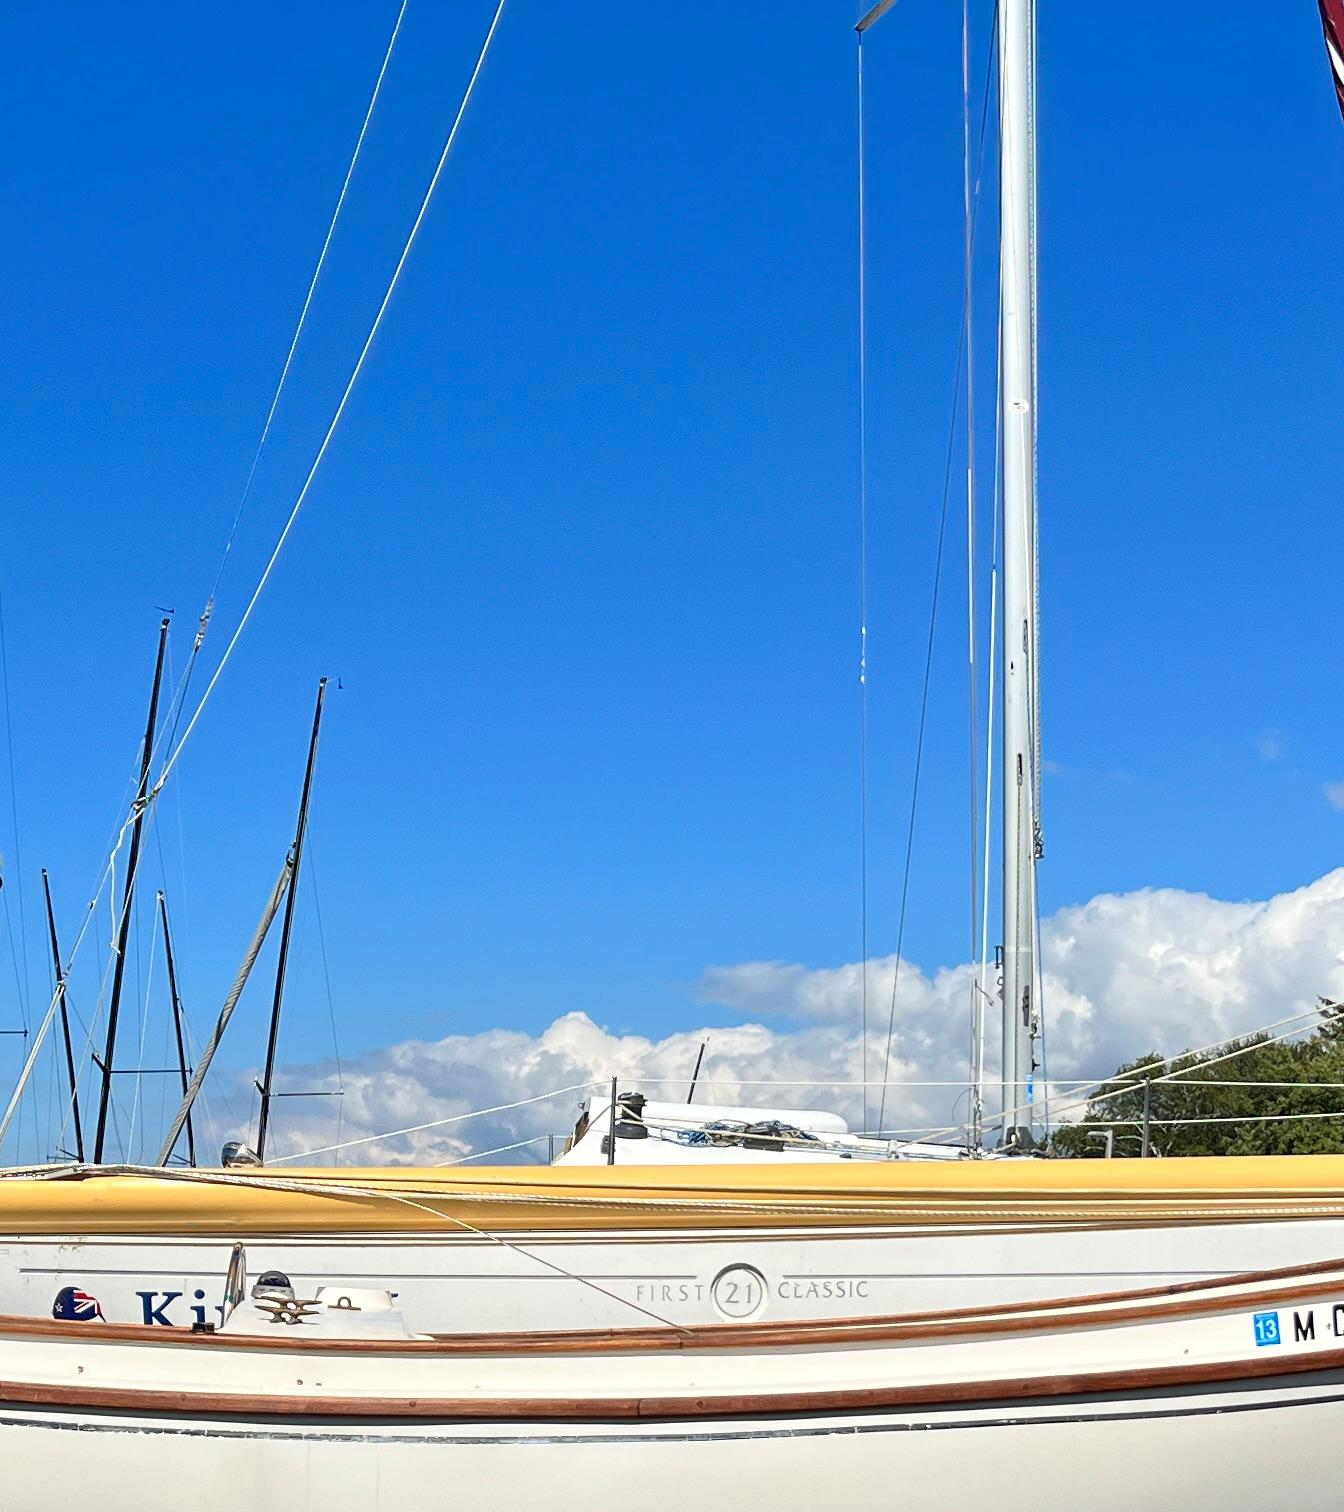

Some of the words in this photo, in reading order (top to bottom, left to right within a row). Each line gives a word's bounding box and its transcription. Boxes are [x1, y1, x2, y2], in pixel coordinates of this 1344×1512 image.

[636, 1284, 705, 1302] FIRST
[724, 1282, 753, 1304] 21
[777, 1281, 870, 1299] CLASSIC
[135, 1289, 224, 1330] Ki
[1256, 1319, 1277, 1340] 13
